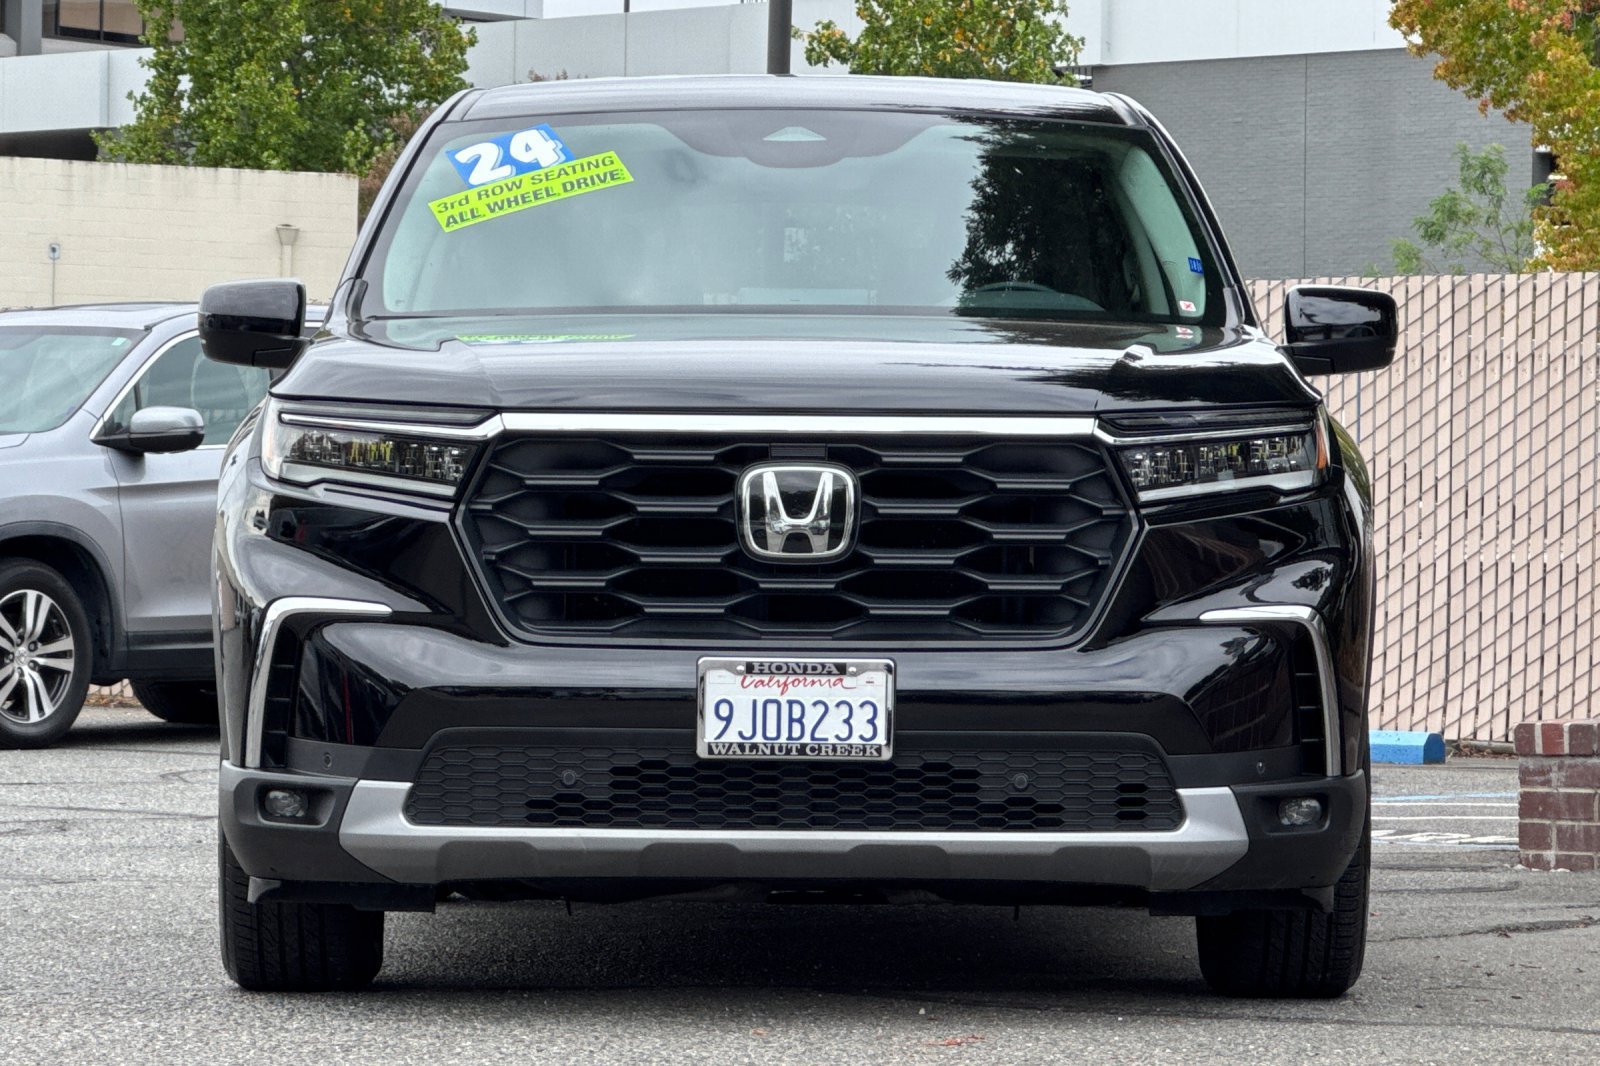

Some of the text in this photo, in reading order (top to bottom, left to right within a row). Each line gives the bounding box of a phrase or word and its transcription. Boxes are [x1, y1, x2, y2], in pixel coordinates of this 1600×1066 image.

[455, 128, 563, 186] 24
[437, 155, 615, 214] 3rd ROW SEATING
[445, 168, 622, 228] ALL WHEEL DRIVE
[740, 675, 857, 696] California
[752, 662, 840, 674] HONDA
[714, 698, 878, 742] 9JOB233
[709, 743, 880, 757] WALNUT CREEK
